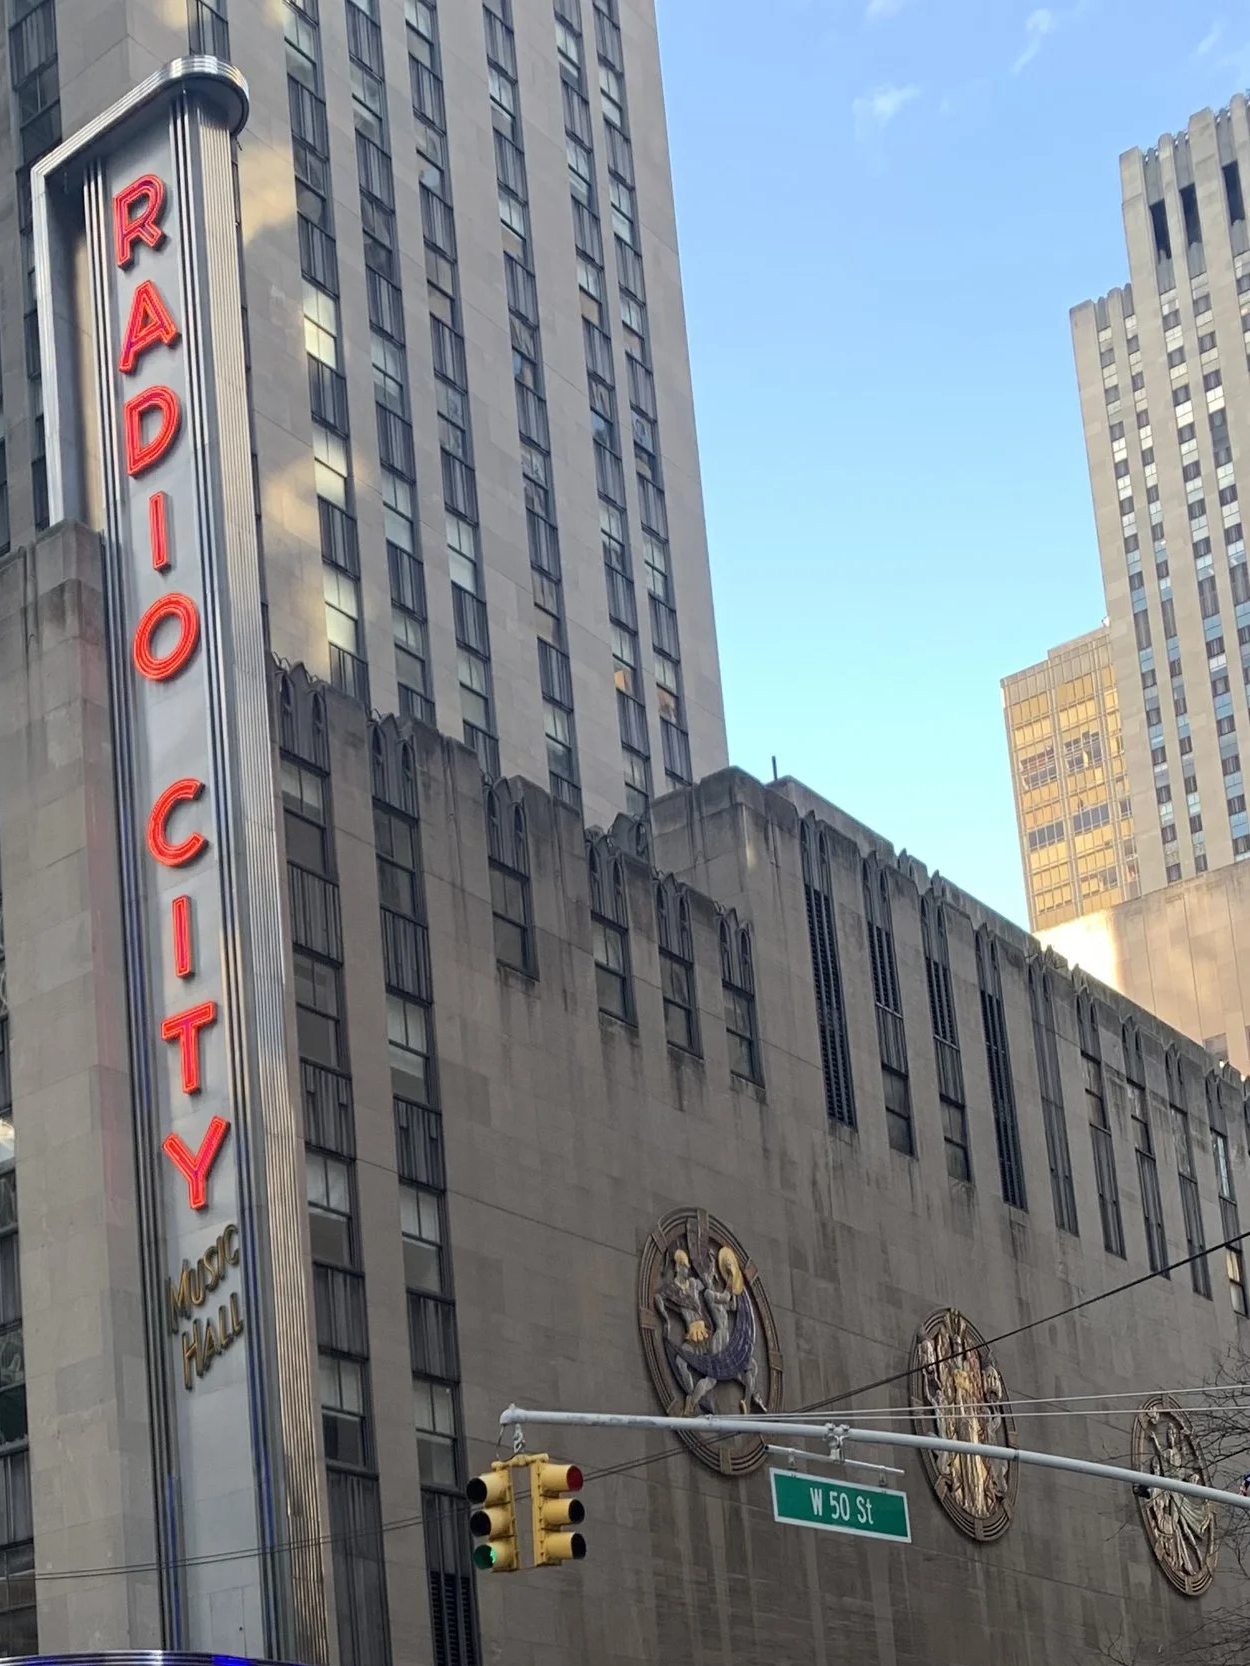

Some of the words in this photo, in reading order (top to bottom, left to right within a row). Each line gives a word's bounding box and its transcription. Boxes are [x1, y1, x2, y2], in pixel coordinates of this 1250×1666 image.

[111, 173, 201, 682] RADIO
[146, 777, 230, 1212] CITY
[166, 1223, 240, 1334] MUSIC
[181, 1291, 244, 1391] HALL
[810, 1488, 823, 1517] W
[829, 1490, 850, 1522] 50
[856, 1495, 874, 1525] St
